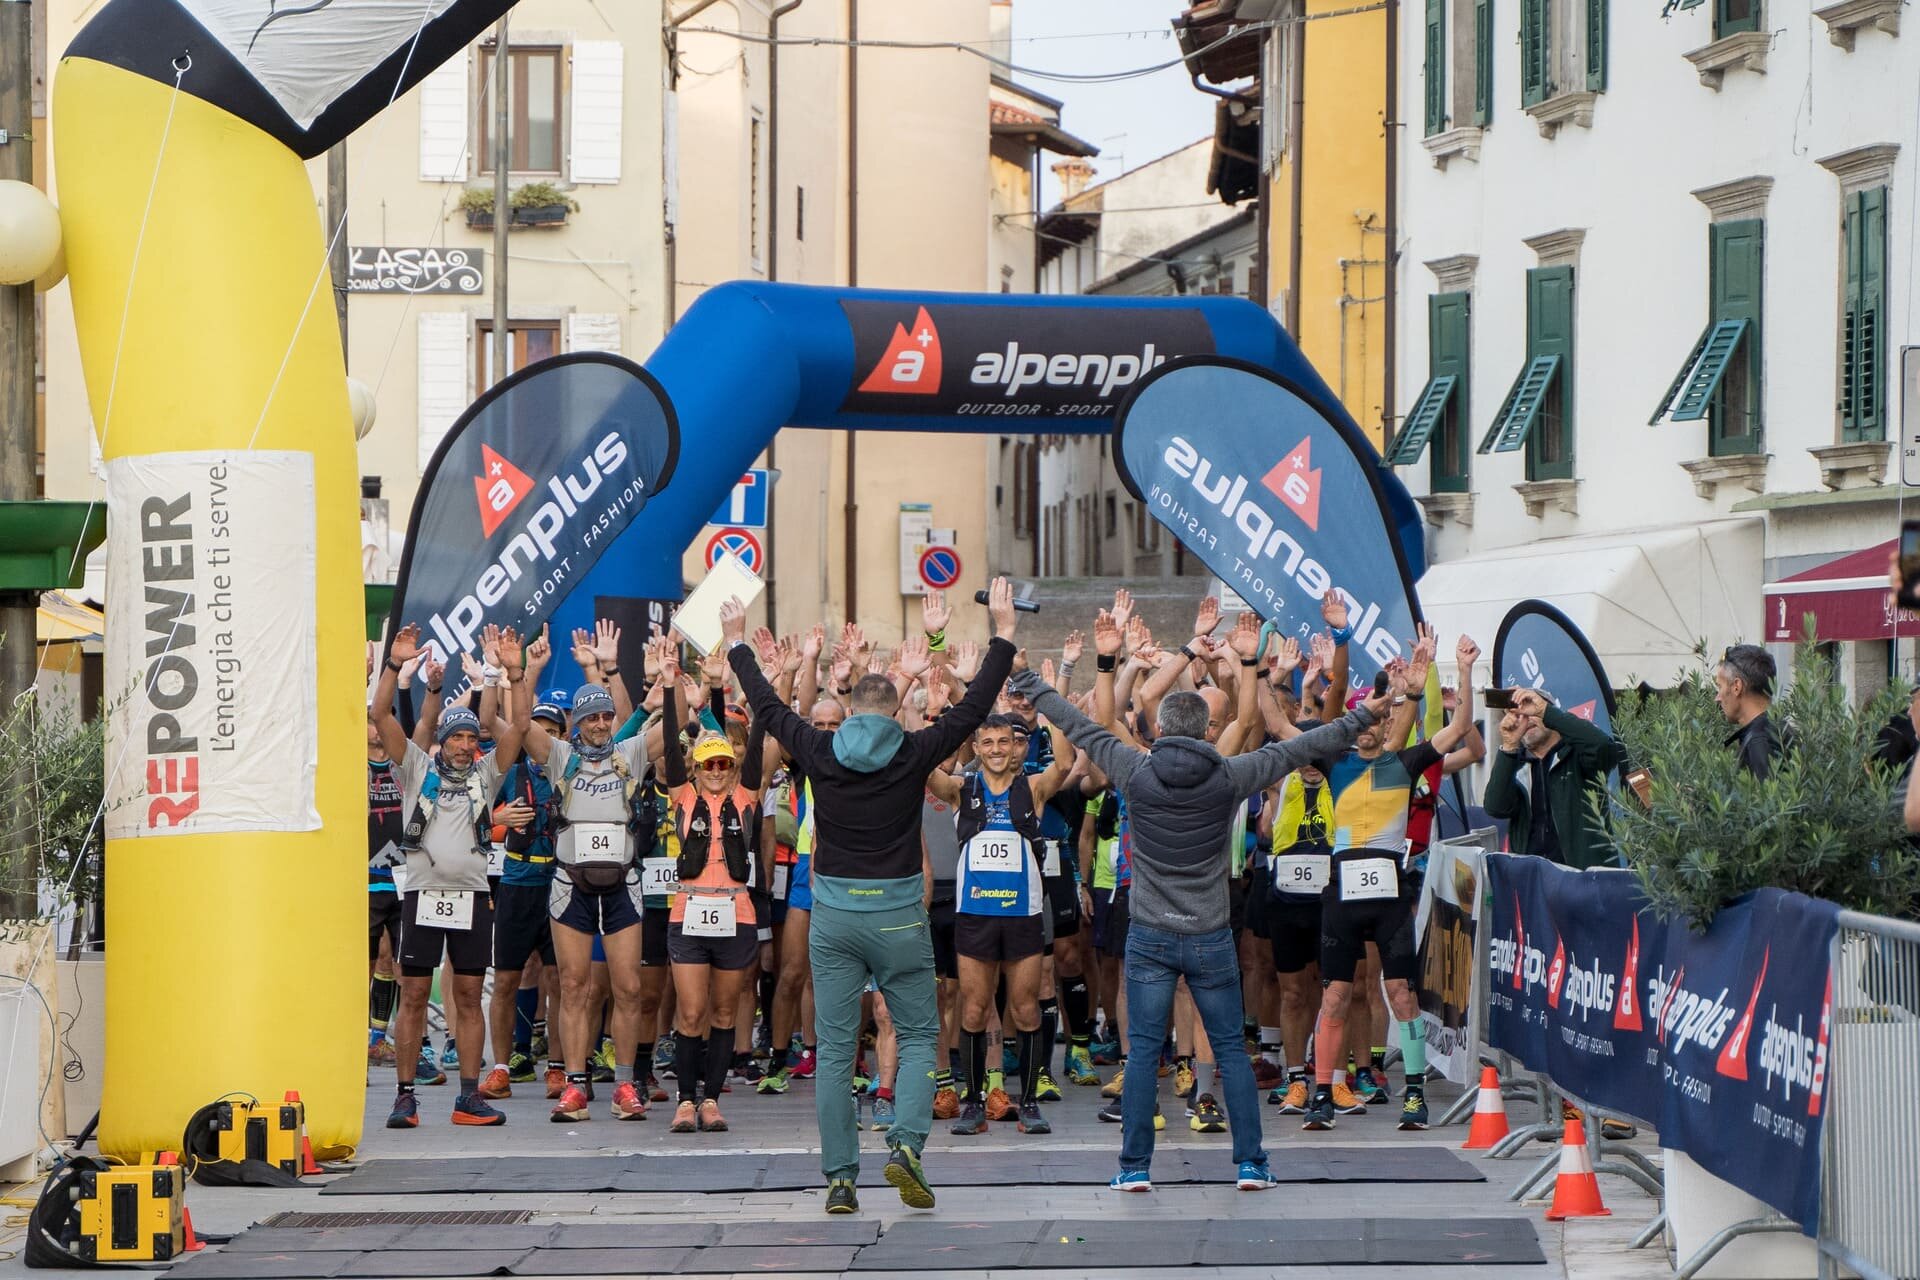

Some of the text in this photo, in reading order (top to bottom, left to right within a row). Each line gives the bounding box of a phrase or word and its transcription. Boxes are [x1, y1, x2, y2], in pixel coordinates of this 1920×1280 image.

[348, 247, 446, 281] KASA
[970, 341, 1184, 397] alpenpl
[956, 403, 1114, 416] OUTDOOR SPORT
[525, 476, 645, 616] SPORT FASHION
[416, 431, 628, 684] alpenplus
[207, 458, 242, 752] L'energia che ti serve.
[141, 491, 200, 829] REPOWER
[370, 793, 391, 801] TRAIL
[591, 835, 610, 850] 84
[981, 843, 1009, 858] 105
[488, 853, 496, 865] 2
[655, 868, 679, 882] 106
[1294, 866, 1312, 881] 96
[1360, 871, 1379, 887] 36
[435, 901, 454, 917] 83
[701, 910, 719, 925] 16
[1760, 1003, 1815, 1101] alpenplus
[1773, 1113, 1793, 1139] SPORT
